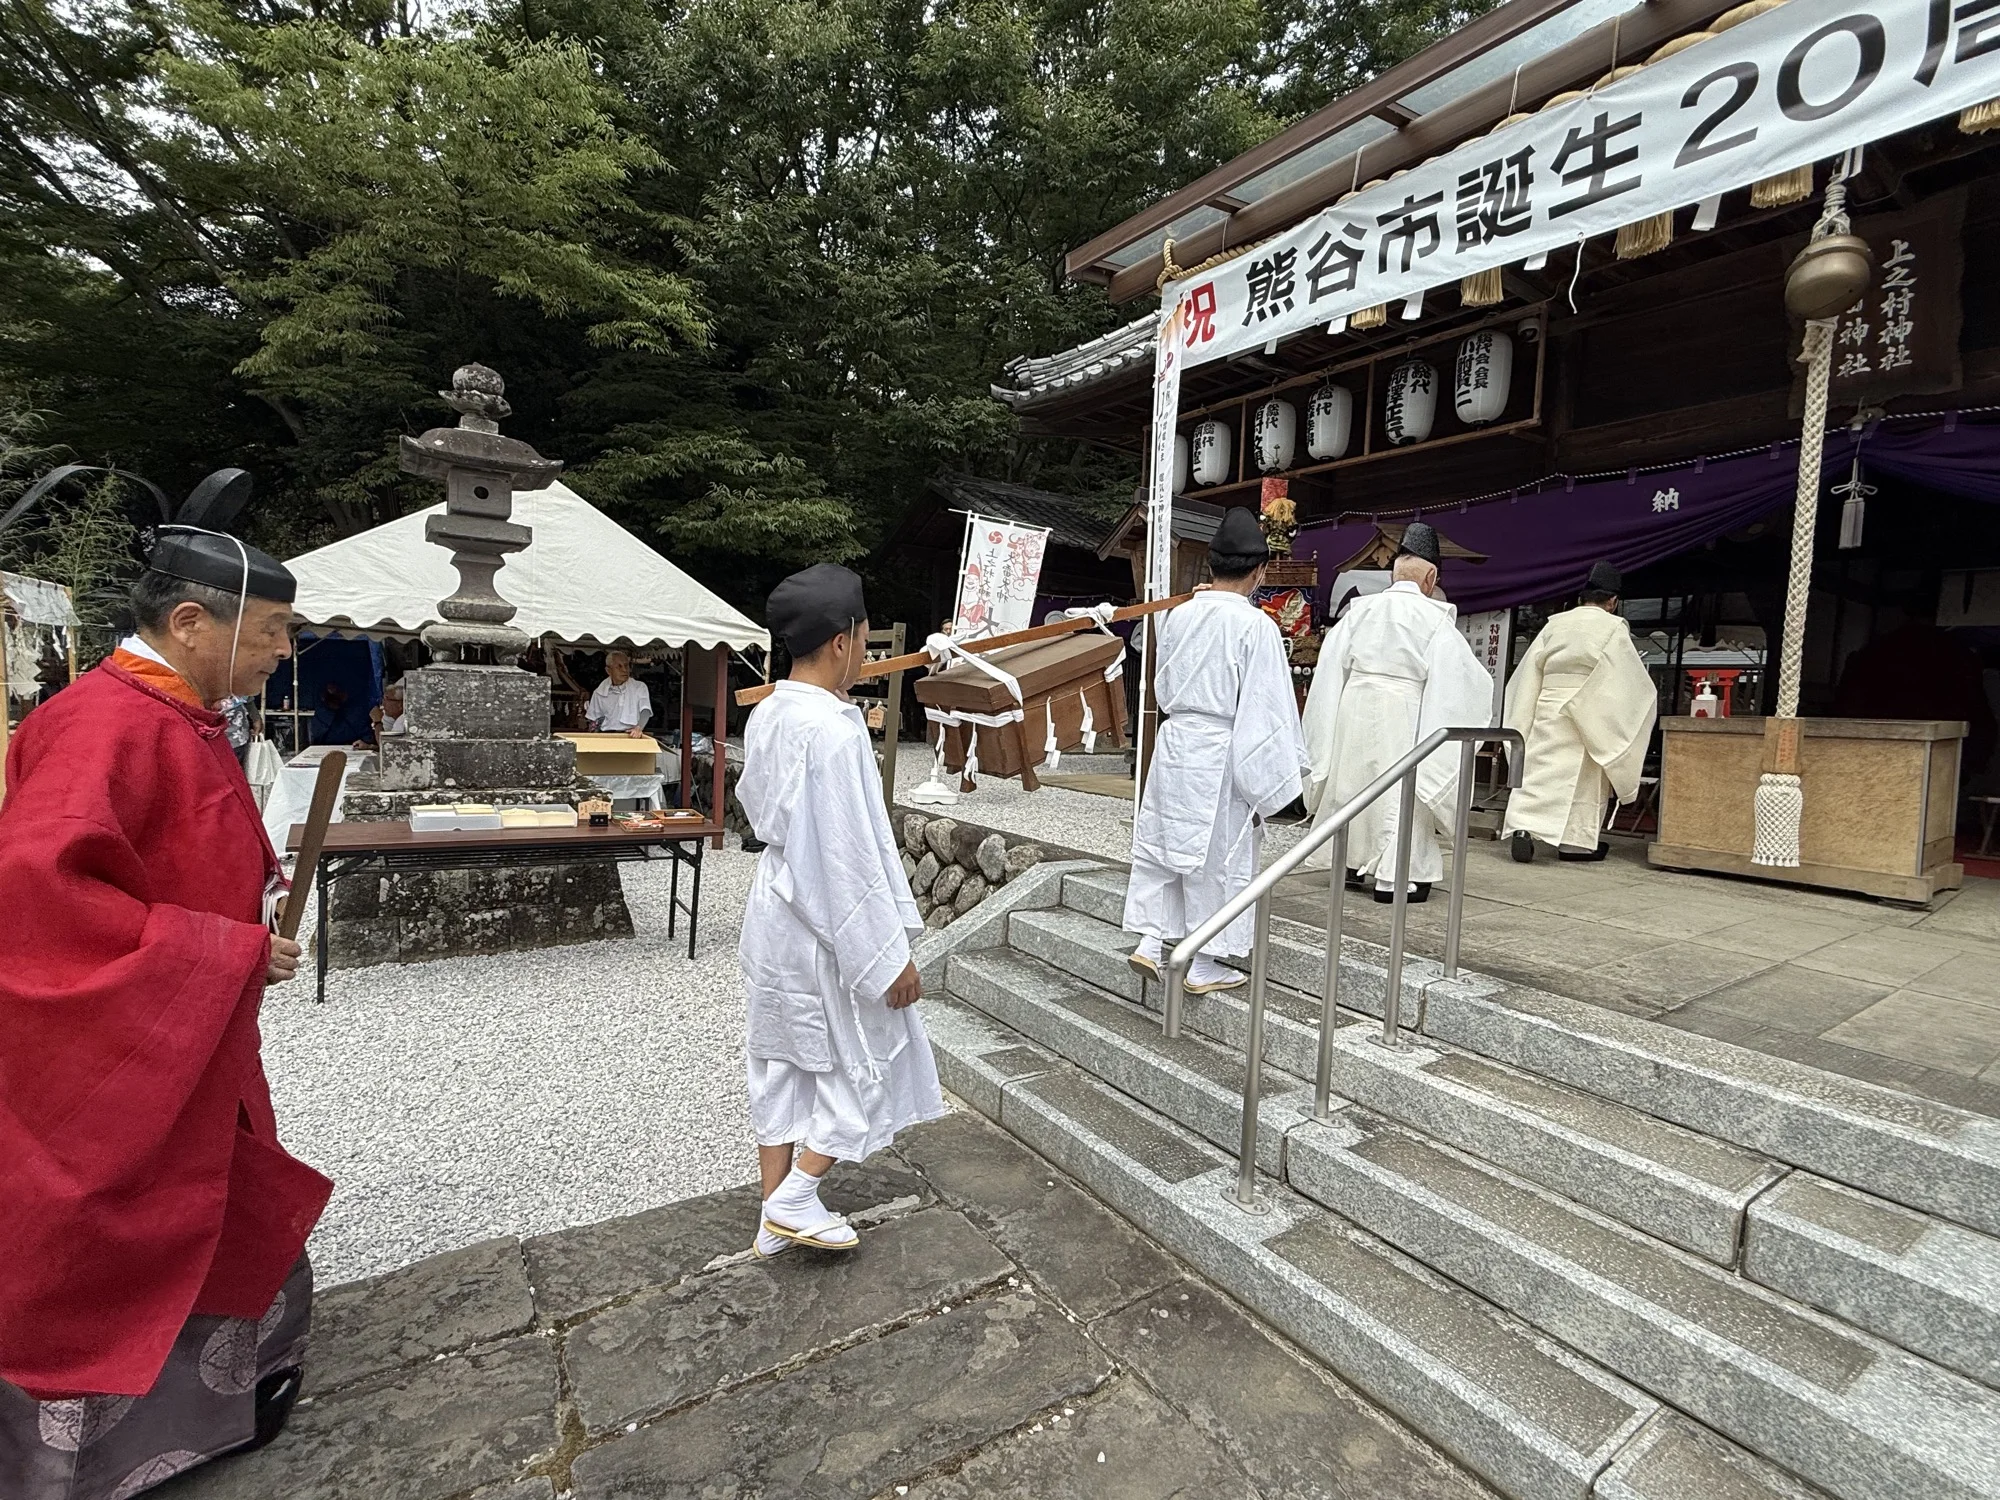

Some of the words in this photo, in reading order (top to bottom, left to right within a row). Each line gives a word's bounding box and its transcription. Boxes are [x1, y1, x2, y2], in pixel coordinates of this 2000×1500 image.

[1181, 281, 1216, 348] 祝
[1878, 239, 1917, 371] 上之村神社
[1837, 299, 1871, 377] 神社
[1410, 364, 1431, 395] 総代
[1266, 403, 1279, 429] 総代
[1316, 385, 1334, 416] 総代
[1202, 422, 1215, 448] 総代
[1652, 487, 1679, 512] 納
[1487, 623, 1501, 679] 特別頒布の
